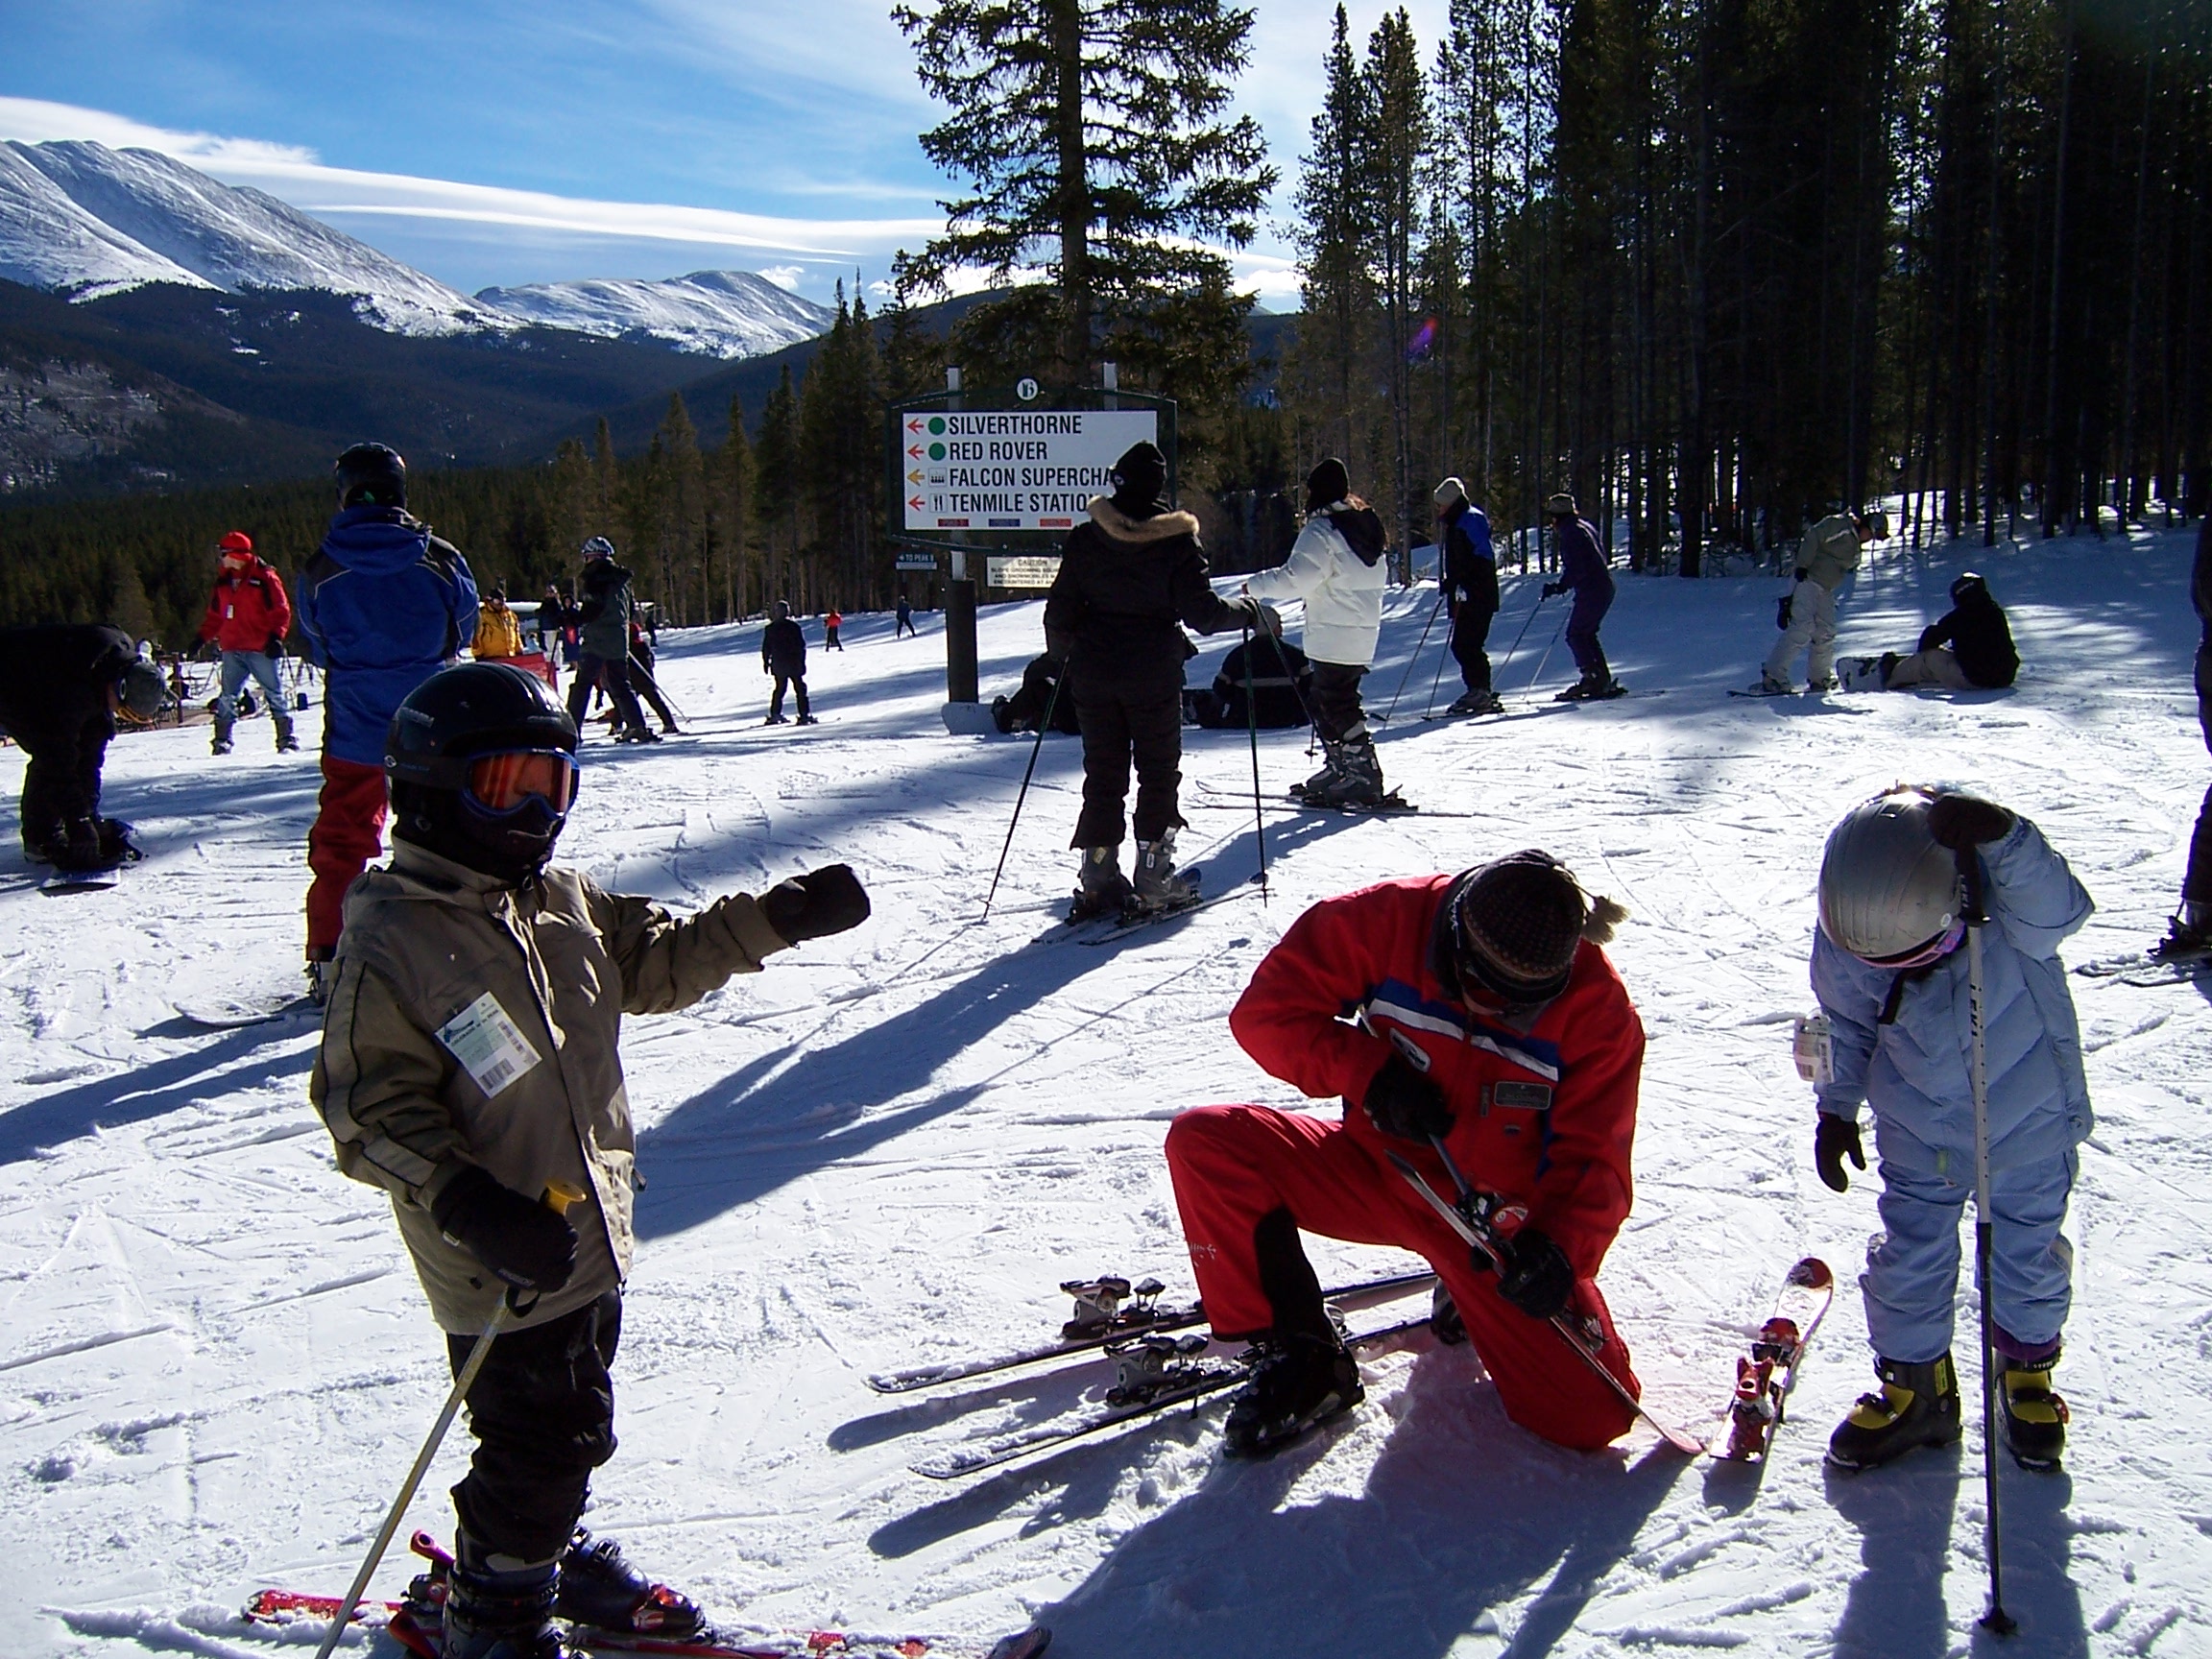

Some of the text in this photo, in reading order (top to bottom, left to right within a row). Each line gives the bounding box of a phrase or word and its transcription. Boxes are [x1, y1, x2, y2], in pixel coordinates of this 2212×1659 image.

[948, 415, 1082, 435] SILVERTHORNE
[950, 442, 1047, 460] RED ROVER
[949, 468, 1015, 487] FALCON
[950, 493, 1099, 512] TENMILE STATIO
